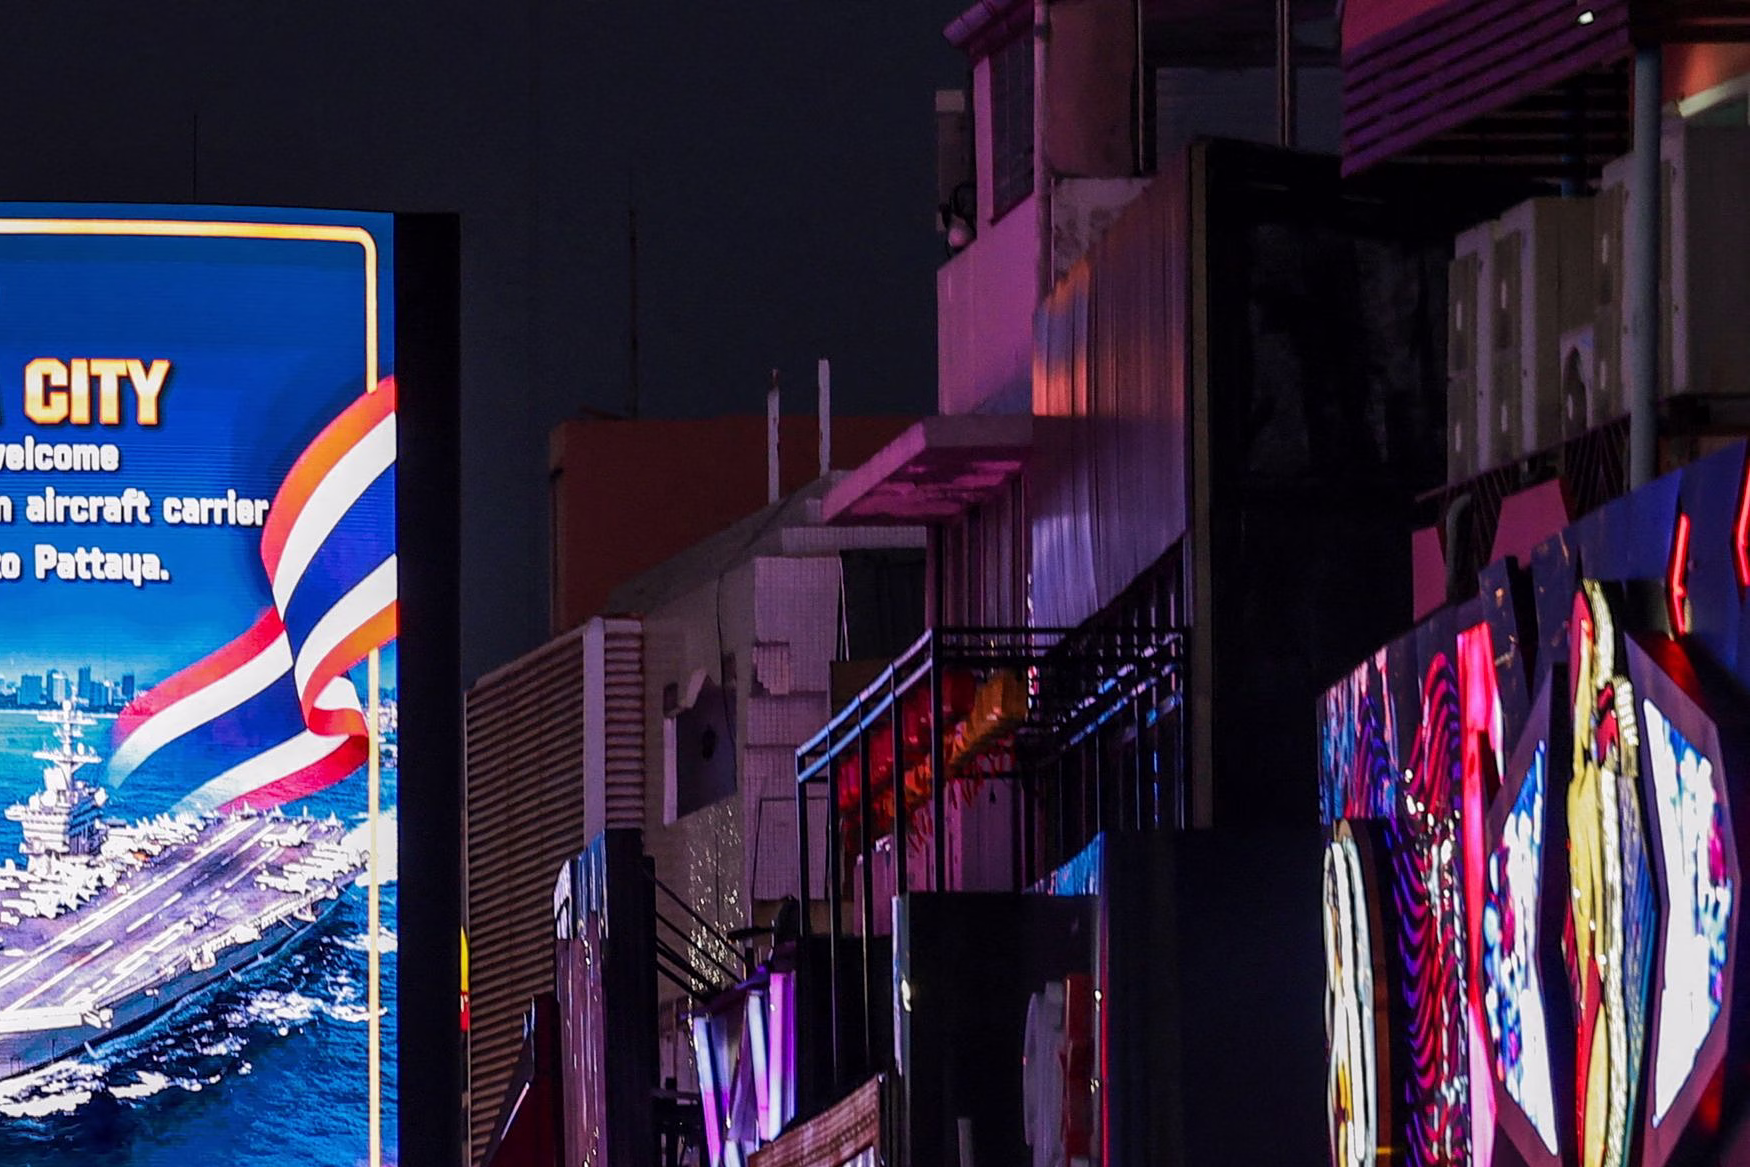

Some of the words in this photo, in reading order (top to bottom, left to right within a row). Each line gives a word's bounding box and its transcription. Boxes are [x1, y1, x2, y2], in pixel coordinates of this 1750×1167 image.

[24, 357, 170, 425] CITY
[25, 486, 150, 524] aircraft
[163, 488, 269, 526] carrier
[34, 543, 170, 587] Pattaya.
